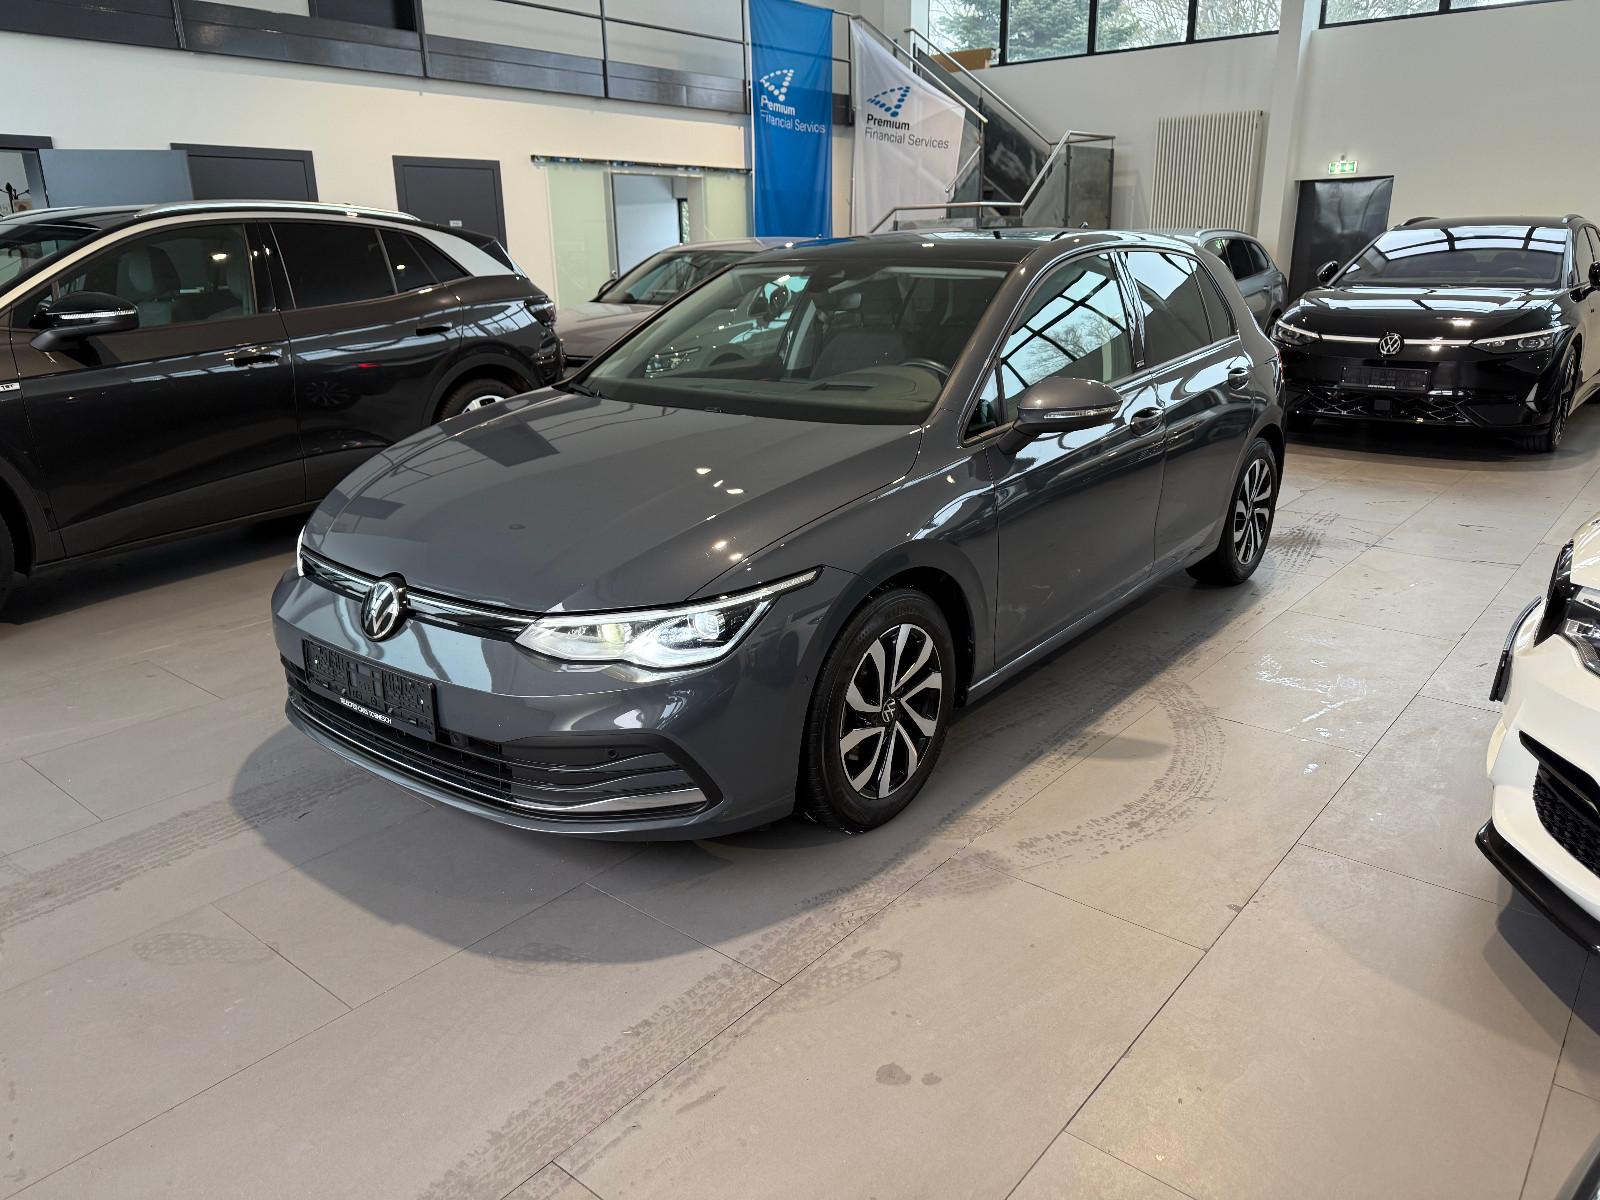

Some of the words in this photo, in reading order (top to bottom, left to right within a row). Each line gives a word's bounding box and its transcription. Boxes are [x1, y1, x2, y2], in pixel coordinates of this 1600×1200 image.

[760, 95, 796, 116] Pemium
[866, 113, 910, 131] Premium
[864, 126, 906, 144] Financial
[907, 133, 949, 150] Services
